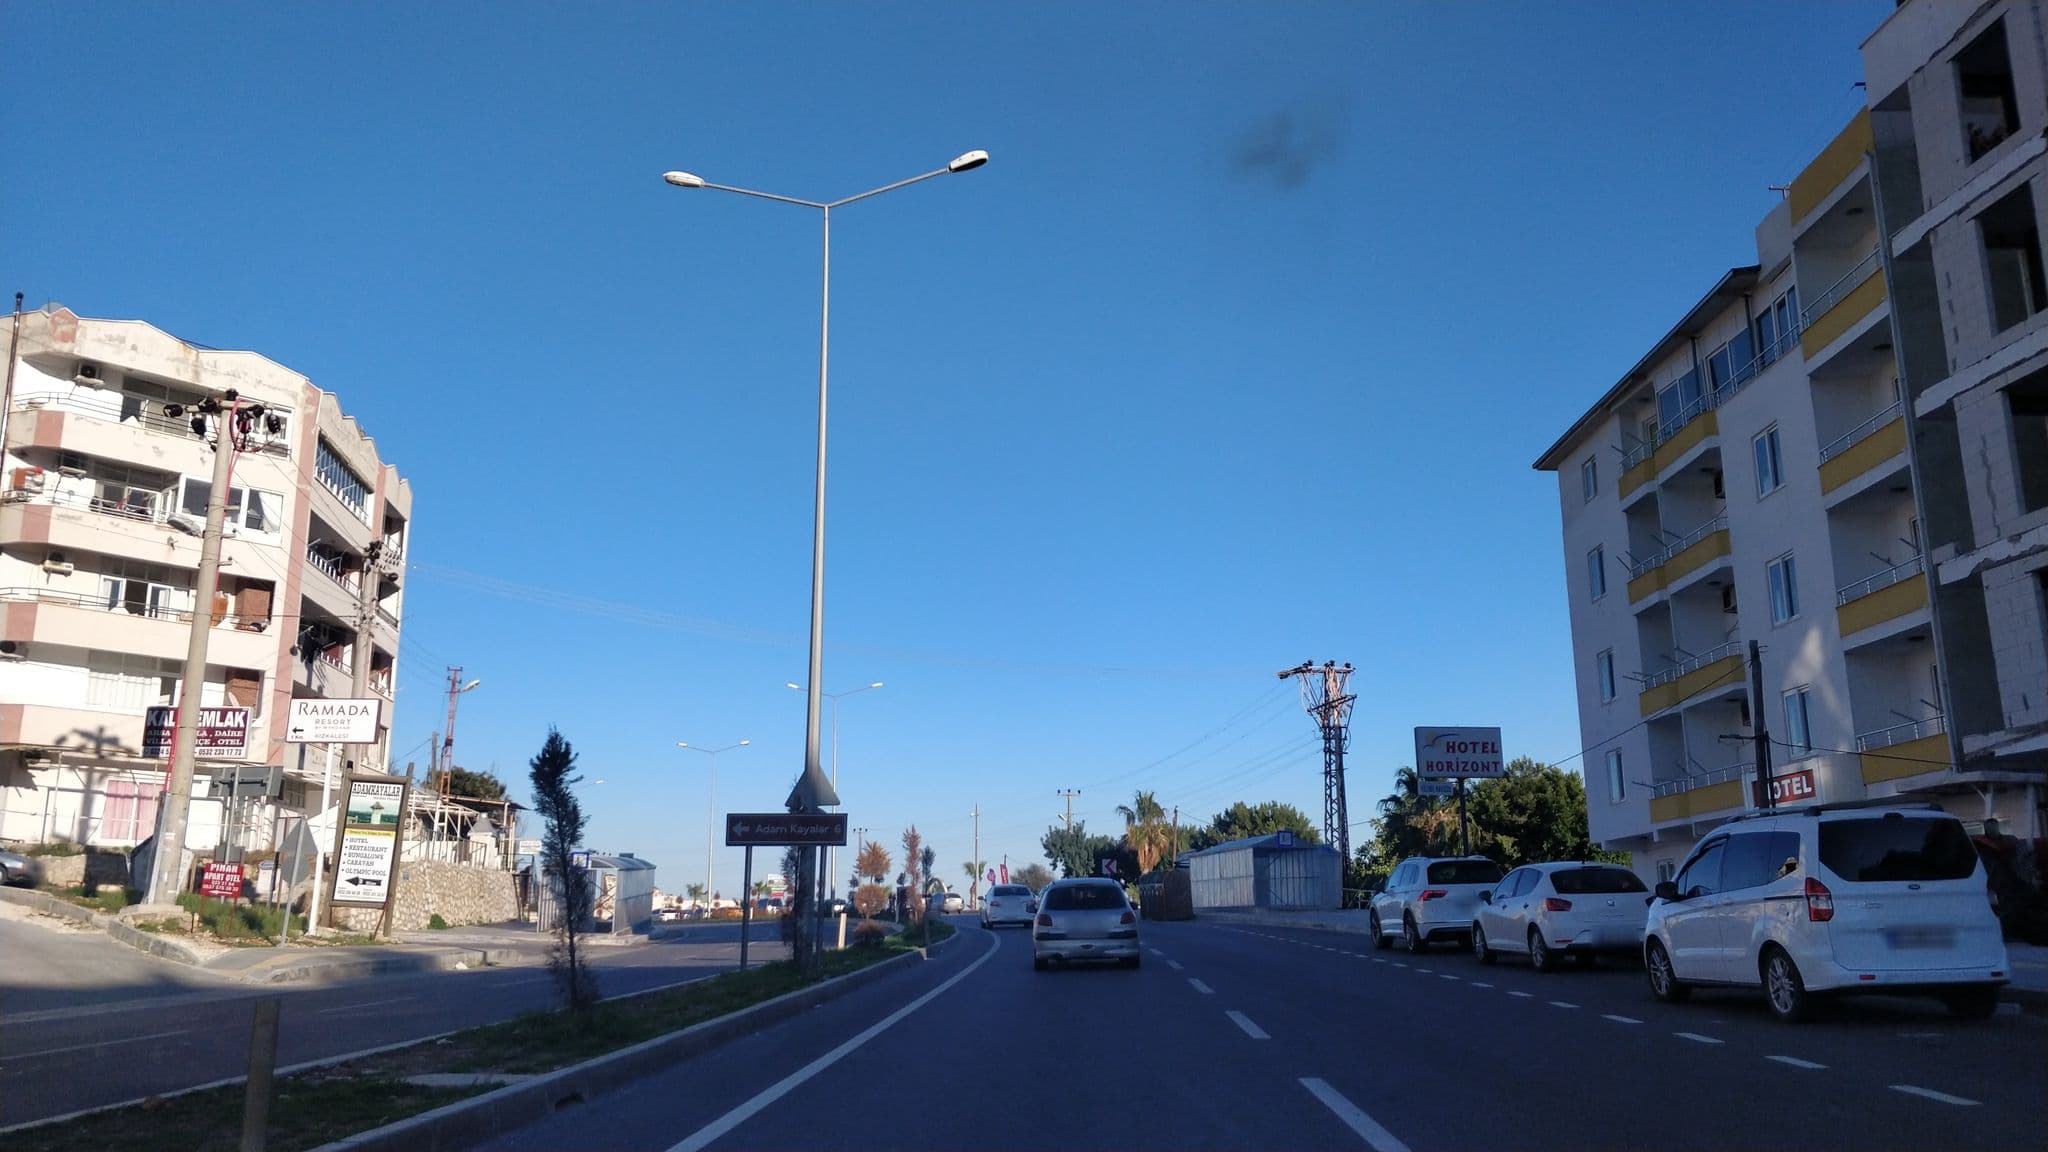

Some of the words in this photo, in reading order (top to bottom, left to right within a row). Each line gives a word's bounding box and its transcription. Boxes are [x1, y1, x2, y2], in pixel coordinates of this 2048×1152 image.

[298, 702, 369, 716] RAMADA
[147, 710, 176, 727] KAL
[217, 738, 242, 746] OTEL
[1446, 741, 1499, 754] HOTEL
[1767, 775, 1812, 800] OTEL
[755, 824, 787, 833] Adam
[790, 824, 830, 836] Kayalar
[349, 845, 388, 853] RESTAURANT
[225, 874, 241, 882] OTEL
